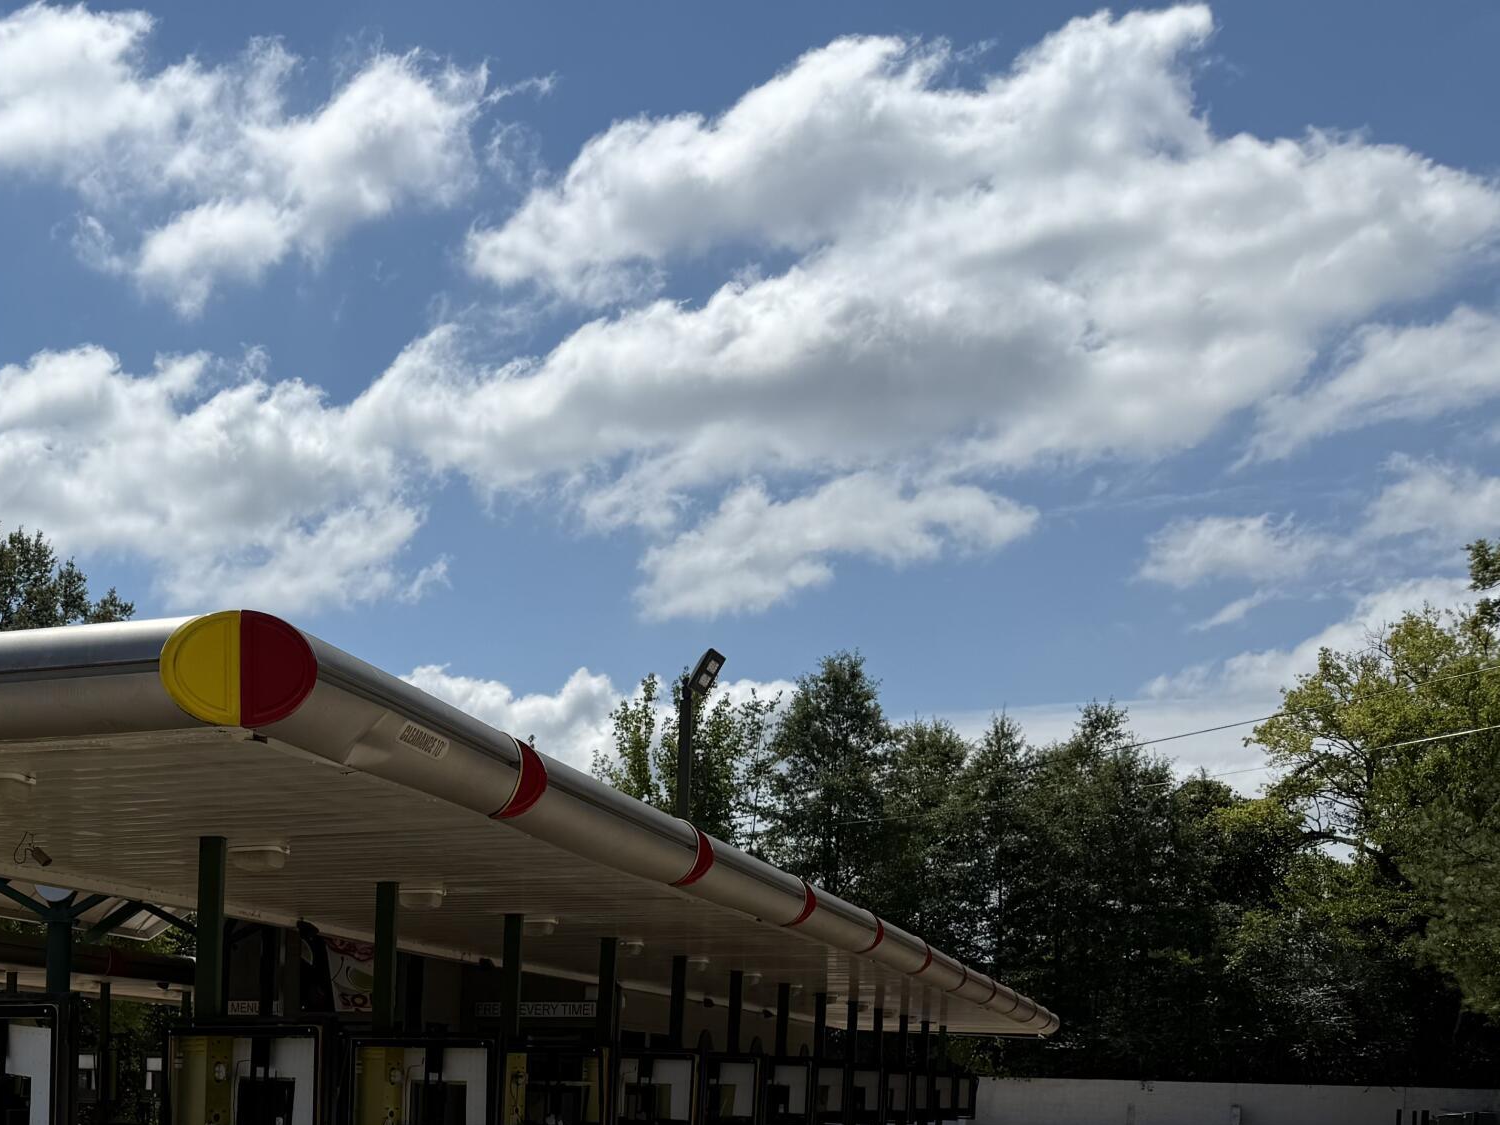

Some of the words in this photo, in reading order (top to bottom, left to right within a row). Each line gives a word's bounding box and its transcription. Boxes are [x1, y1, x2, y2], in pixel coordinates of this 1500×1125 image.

[399, 724, 438, 753] CLEARANCE
[230, 1001, 260, 1014] MENU
[476, 1003, 500, 1015] FRE
[519, 1003, 558, 1016] EVERY
[562, 1003, 594, 1016] TIME!
